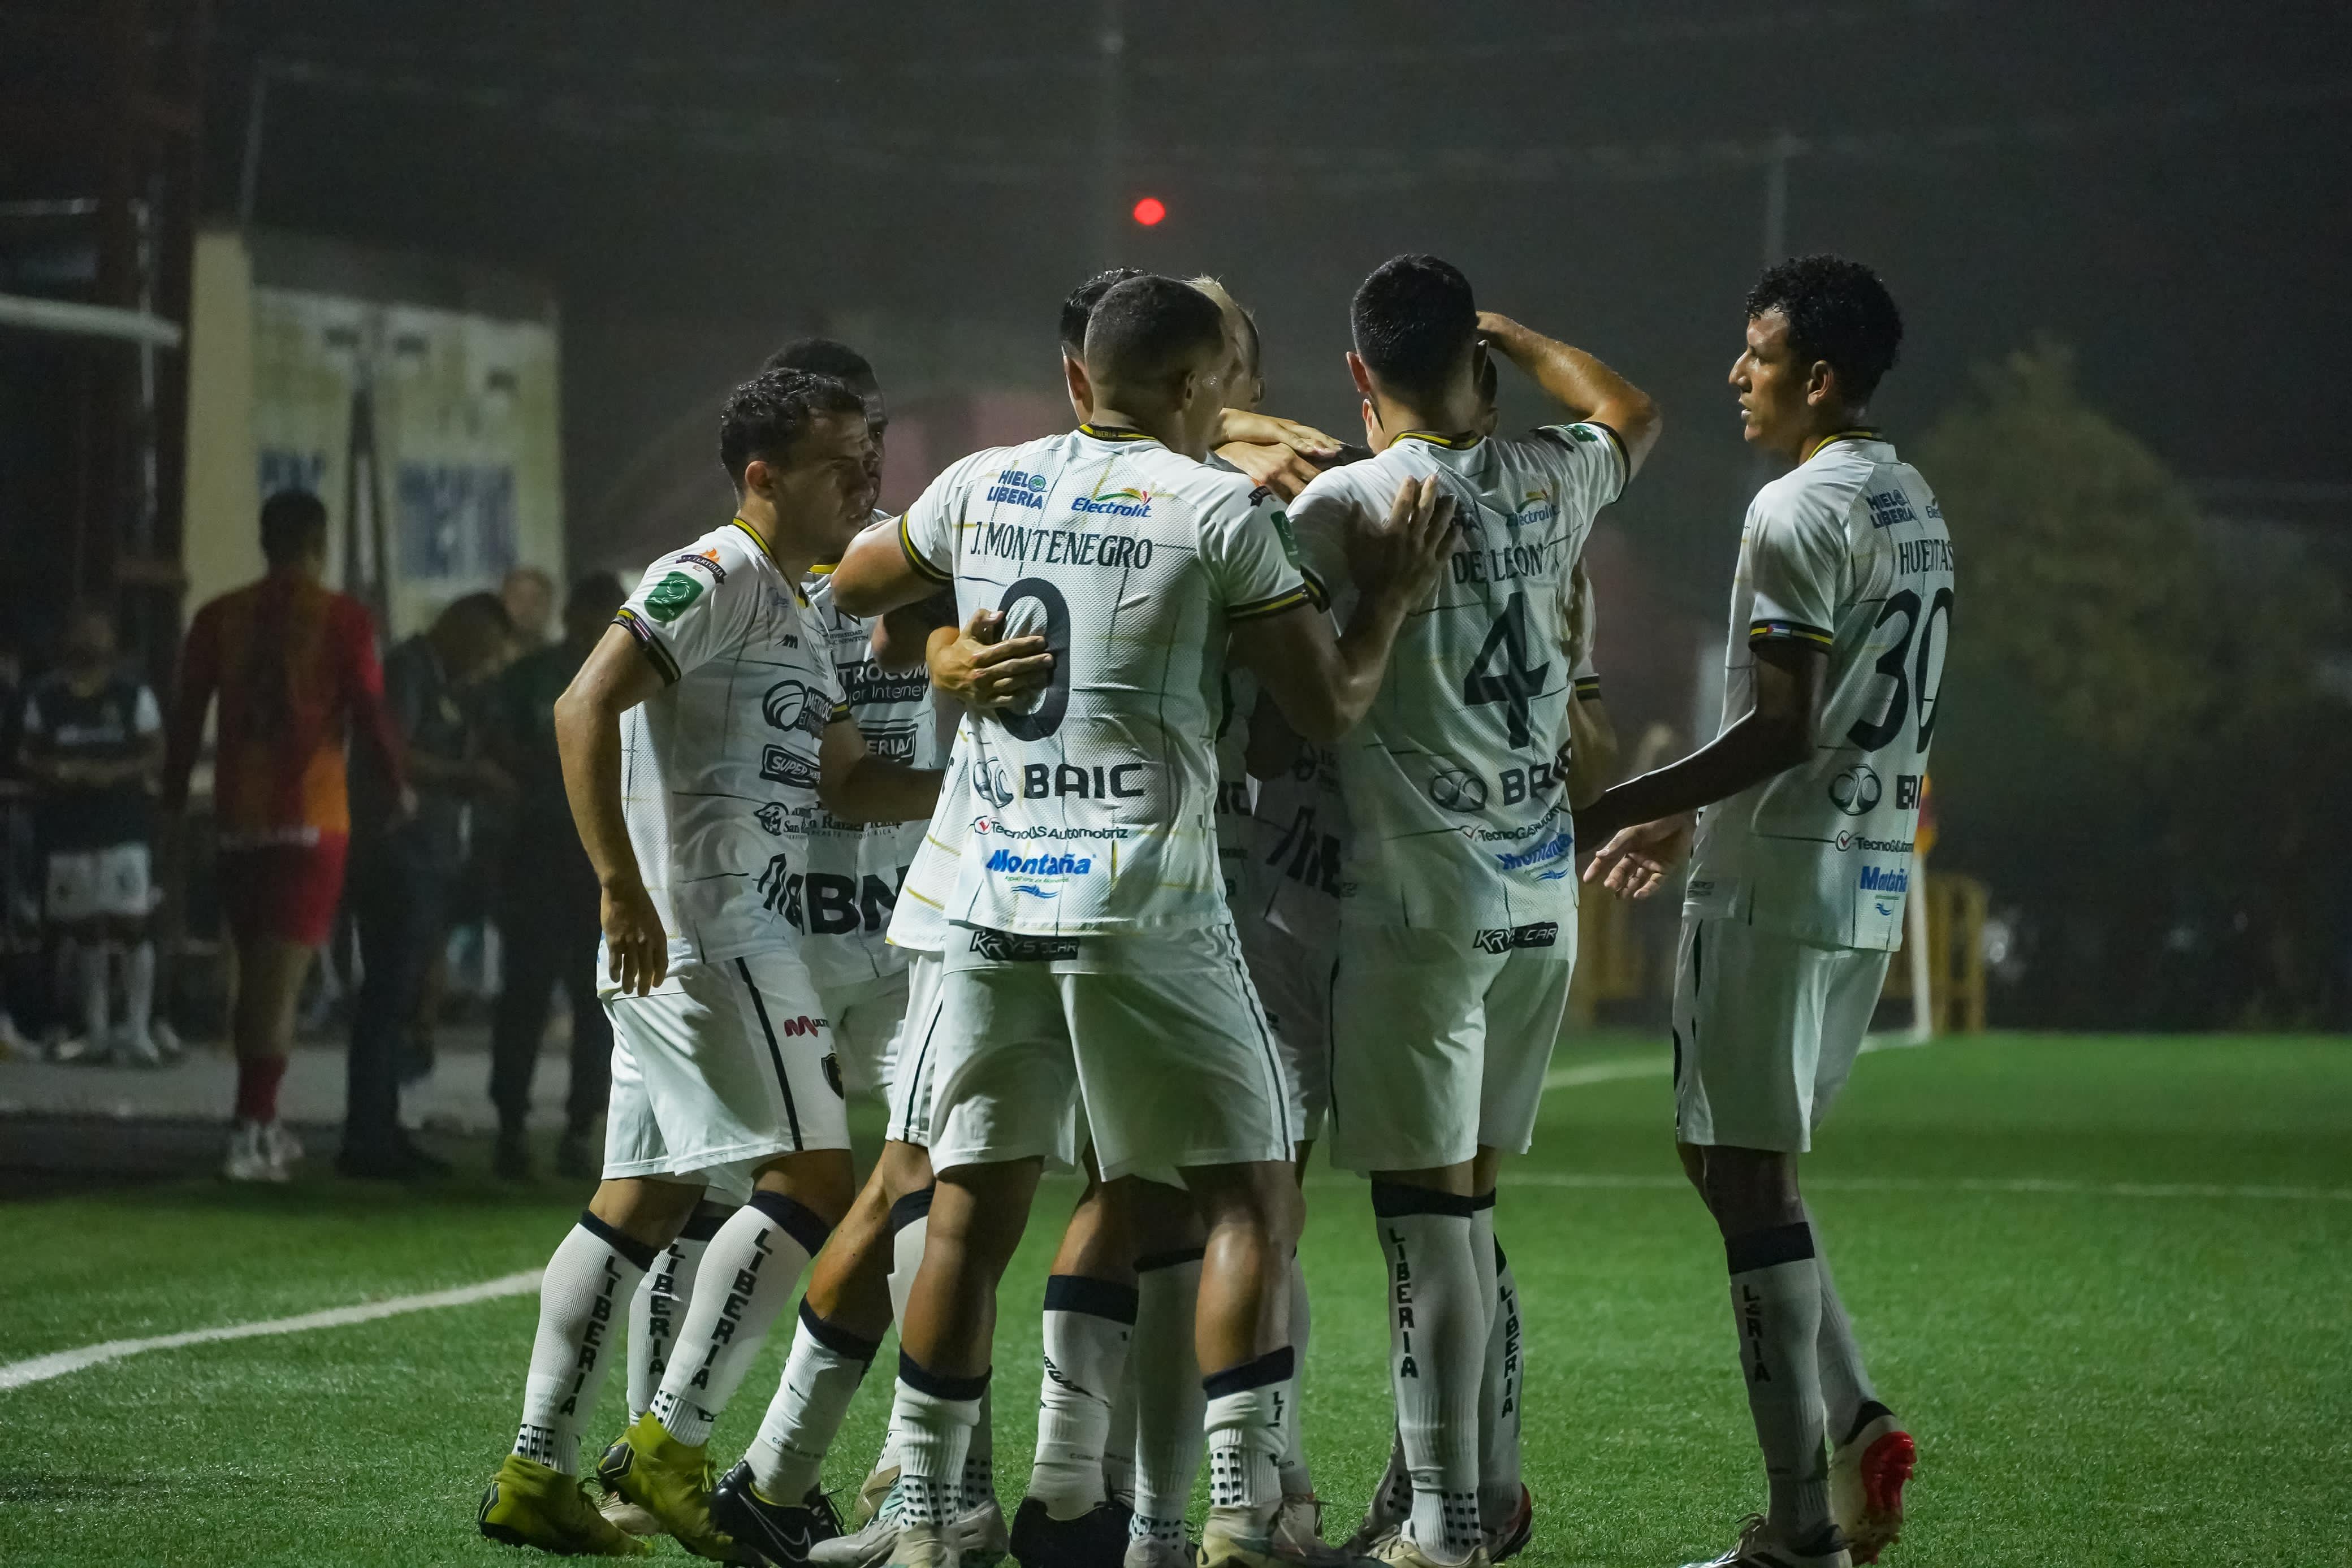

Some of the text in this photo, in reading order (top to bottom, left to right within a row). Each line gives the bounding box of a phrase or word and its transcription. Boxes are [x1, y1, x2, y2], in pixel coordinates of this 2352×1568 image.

[987, 487, 1043, 509] LIBERIA
[1071, 497, 1152, 517] Electrolit
[1870, 507, 1917, 529] LIBERIA
[1452, 550, 1488, 584] DE
[1464, 591, 1550, 750] 4
[1846, 587, 1955, 754] 30
[872, 683, 928, 700] Internet
[771, 755, 807, 776] SUPER
[1024, 763, 1146, 799] BAIC
[986, 849, 1091, 876] Montaña
[649, 1243, 685, 1376] LIBERIA
[690, 1228, 773, 1390] LIBERIA
[1389, 1228, 1419, 1378] LIBERIA
[559, 1255, 621, 1417] LIBERIA
[1499, 1285, 1520, 1419] LIBERIA
